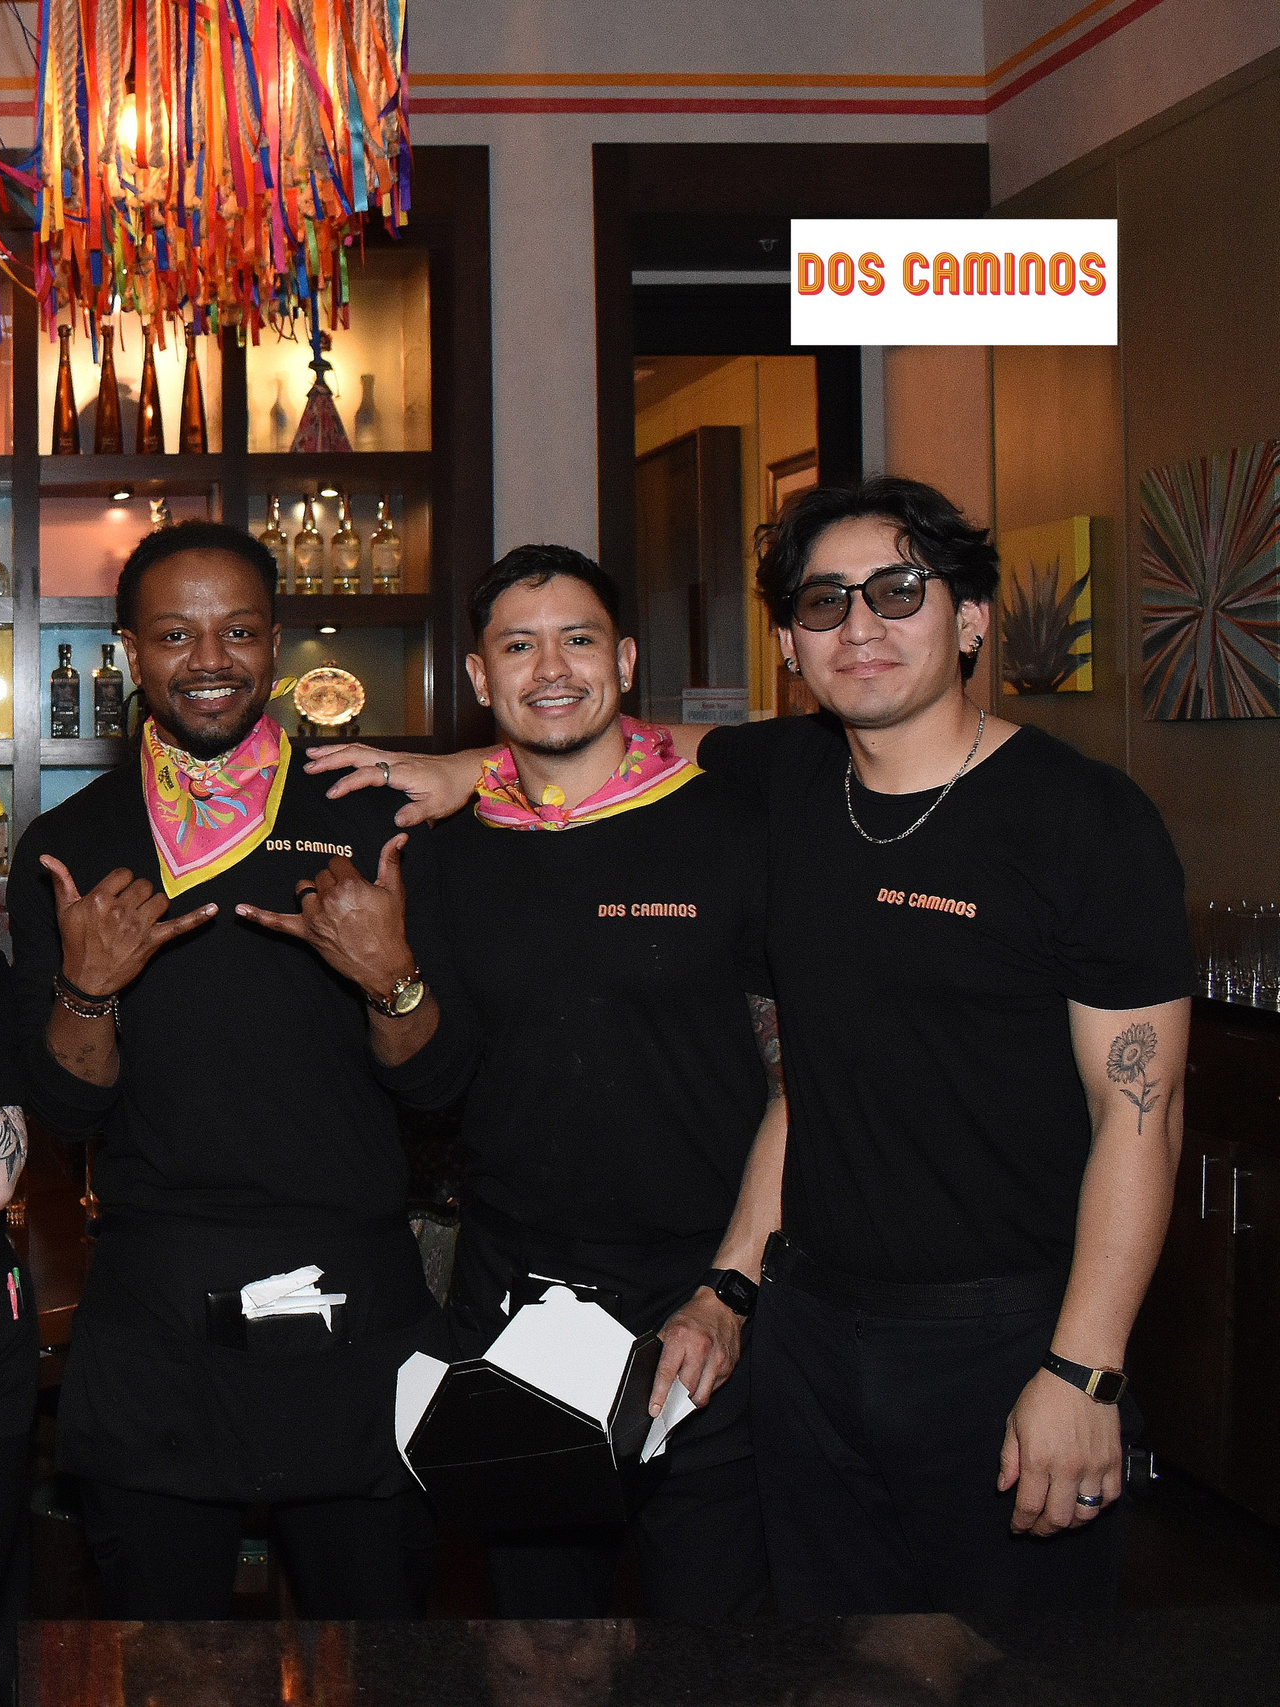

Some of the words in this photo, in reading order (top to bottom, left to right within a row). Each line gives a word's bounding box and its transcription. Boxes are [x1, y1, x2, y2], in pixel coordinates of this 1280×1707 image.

[266, 839, 292, 851] DOS
[295, 840, 353, 858] CAMINOS
[598, 904, 626, 917] DOS
[631, 903, 697, 918] CAMINOS
[877, 888, 906, 905] DOS
[908, 892, 977, 919] CAMINOS
